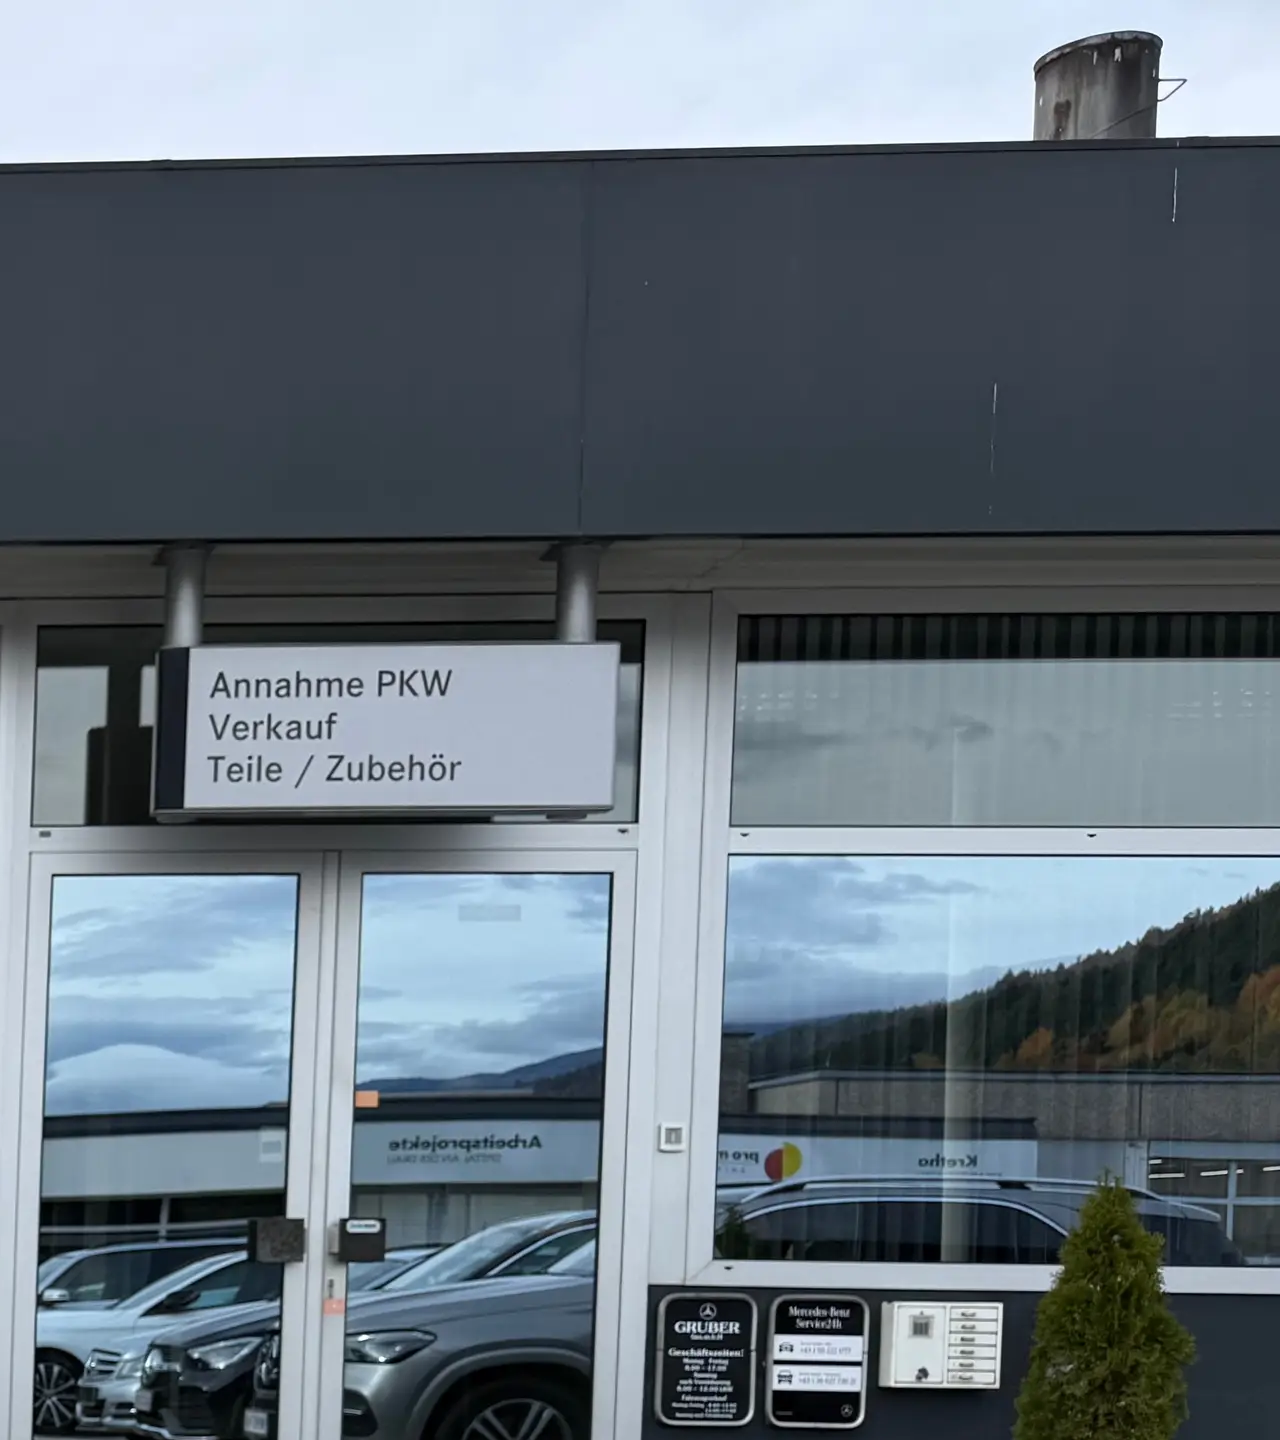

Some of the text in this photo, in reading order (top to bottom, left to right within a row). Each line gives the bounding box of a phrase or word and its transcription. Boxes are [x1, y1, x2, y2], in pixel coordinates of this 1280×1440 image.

[209, 669, 453, 699] Annahme PKW
[208, 712, 338, 741] Verkauf
[207, 753, 463, 789] Teile / Zubehör
[674, 1320, 741, 1335] GRUBER
